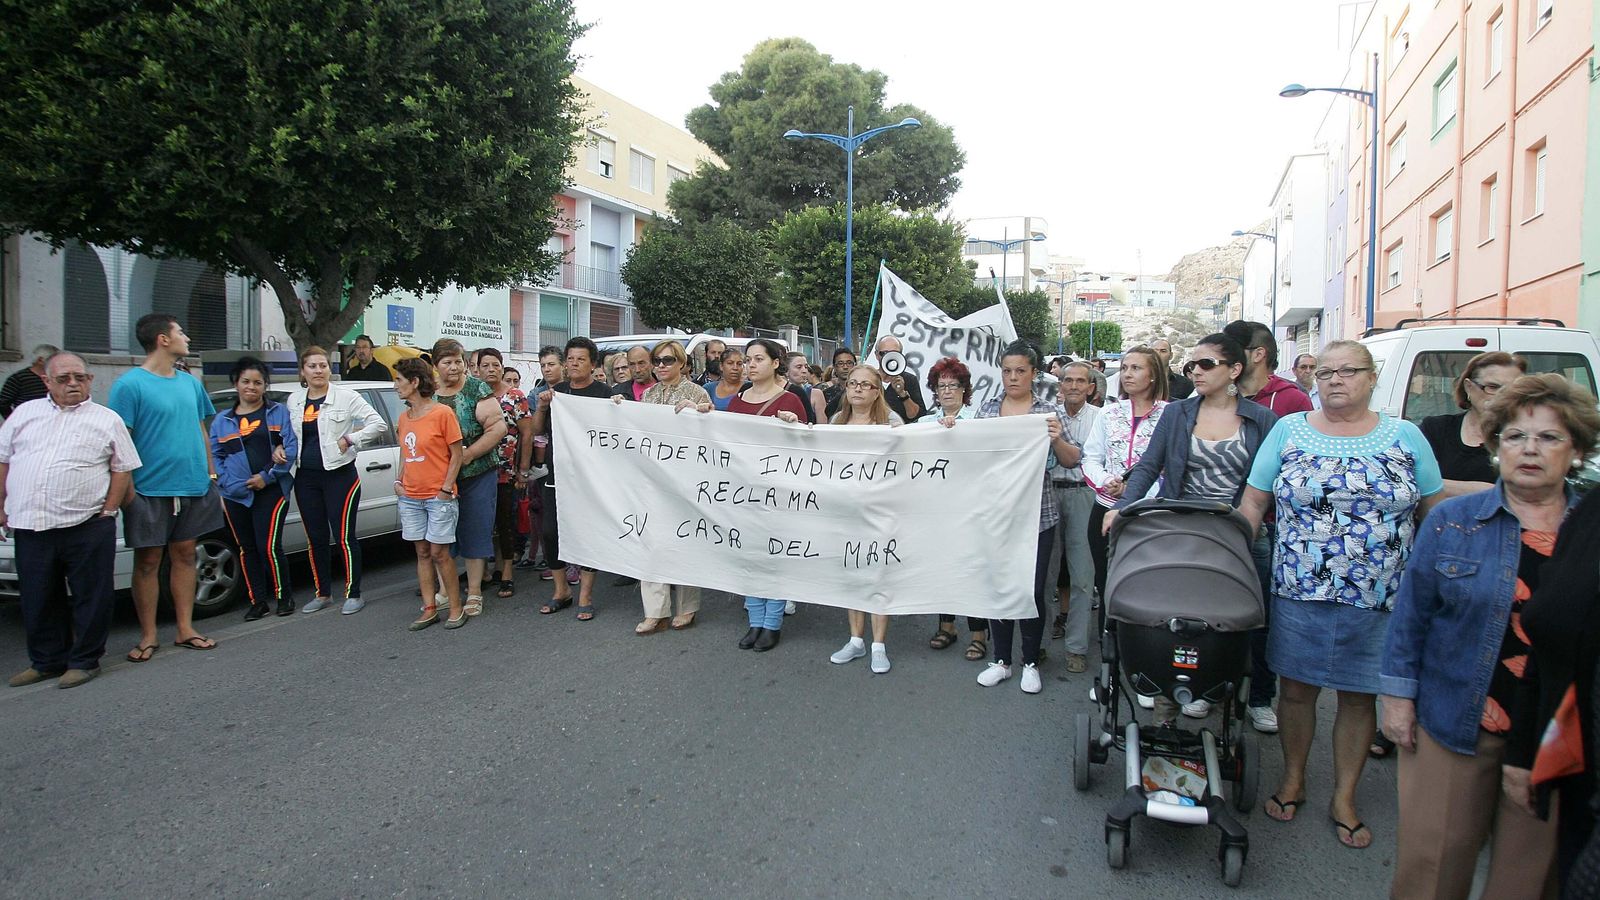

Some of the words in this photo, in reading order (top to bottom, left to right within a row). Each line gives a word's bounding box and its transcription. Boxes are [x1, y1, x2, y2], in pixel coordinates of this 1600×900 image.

[464, 323, 502, 333] OPORTUNIDADES
[467, 316, 488, 324] INCLUIDA
[441, 328, 470, 337] LABORALES
[586, 429, 731, 469] PESCADERIA
[759, 455, 949, 481] INDIGNADA
[696, 480, 820, 512] RECLAMA
[676, 518, 742, 550] CASA
[768, 537, 820, 559] DEL
[843, 538, 902, 569] MAR
